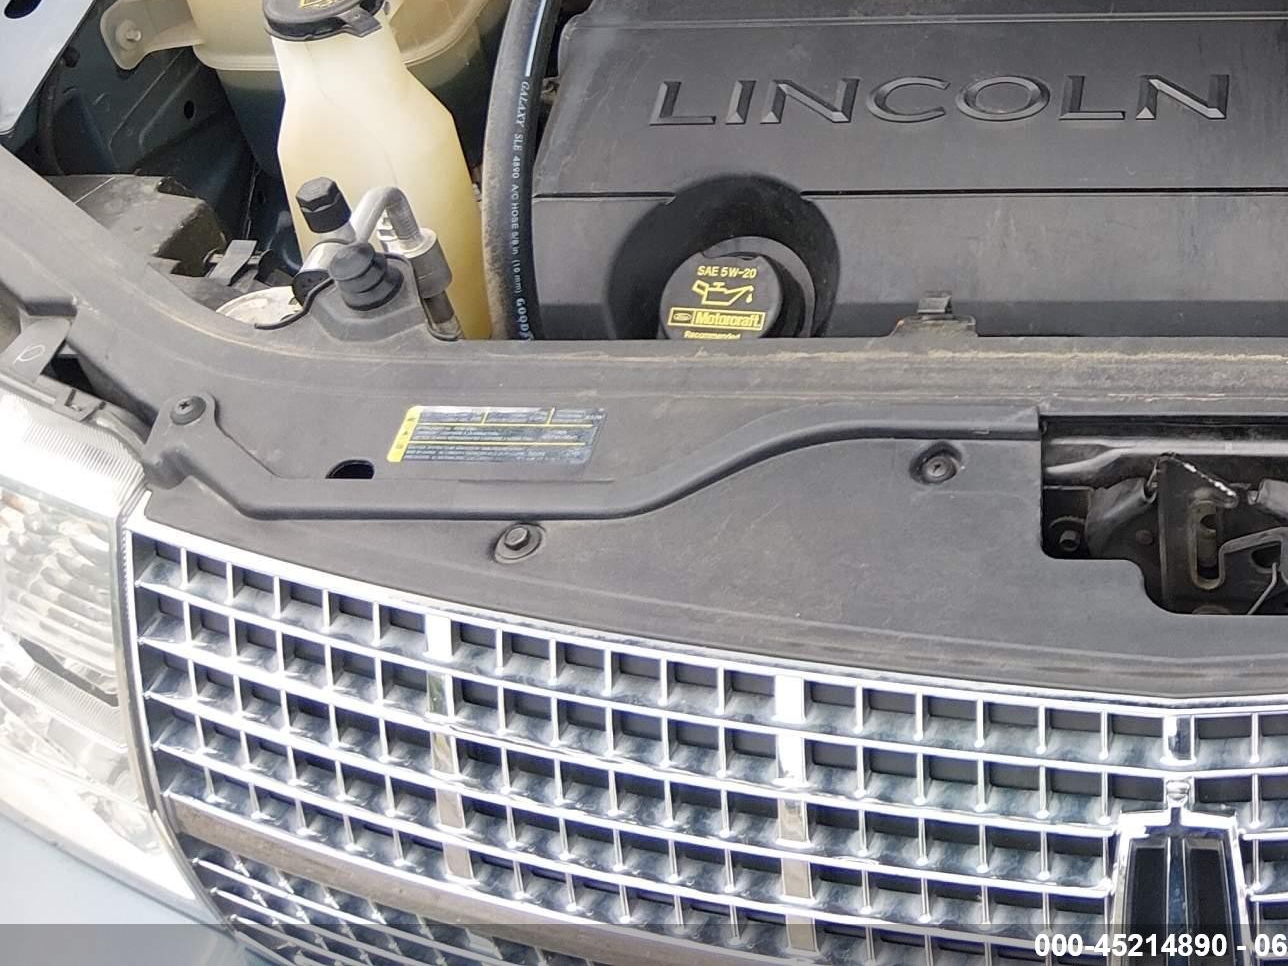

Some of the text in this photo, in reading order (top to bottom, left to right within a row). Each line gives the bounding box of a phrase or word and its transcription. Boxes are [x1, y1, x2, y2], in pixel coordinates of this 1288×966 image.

[515, 81, 530, 127] GALAXY
[648, 74, 1231, 126] LINCOLN
[511, 202, 519, 229] HOSE
[697, 265, 757, 279] SAE 5W-20
[695, 312, 760, 328] Motorcraft
